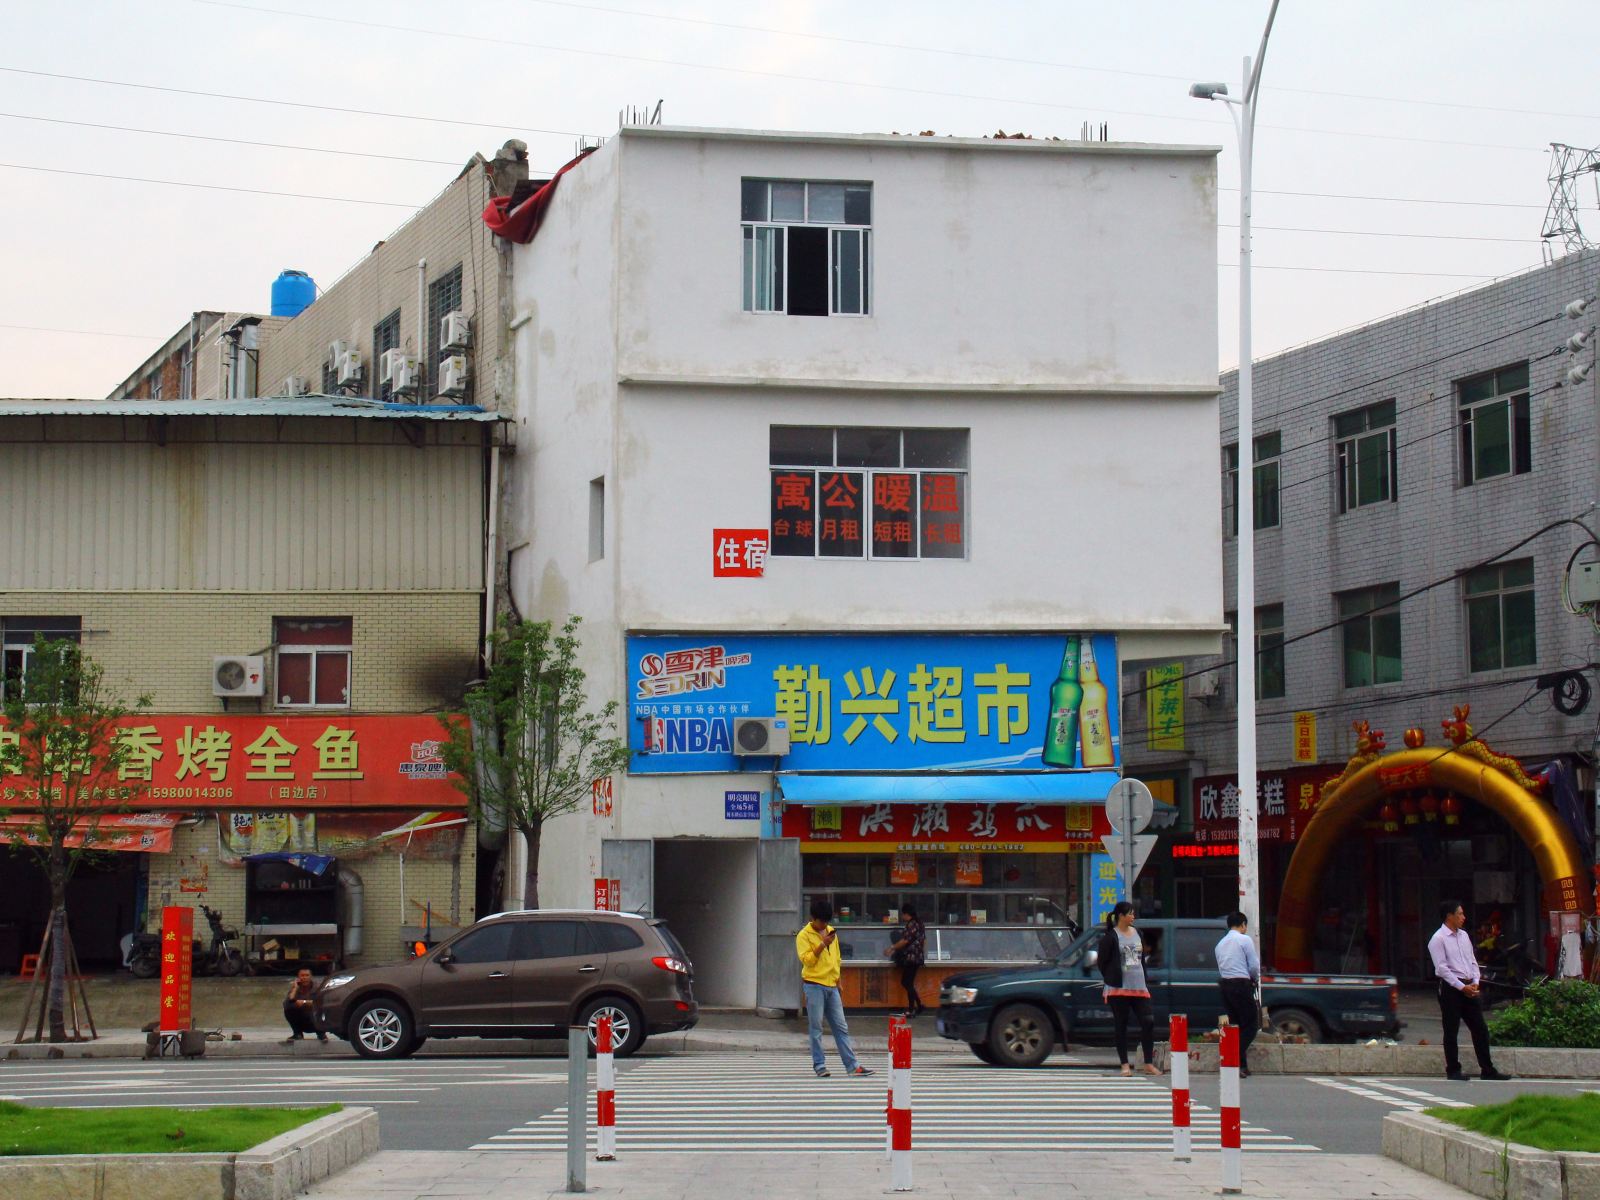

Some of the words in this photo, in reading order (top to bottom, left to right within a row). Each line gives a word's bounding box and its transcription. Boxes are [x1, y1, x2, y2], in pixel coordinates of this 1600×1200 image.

[774, 519, 813, 537] 台球
[822, 520, 859, 541] 月租
[874, 521, 912, 543] 短租
[924, 523, 961, 545] 长租
[716, 537, 767, 570] 住宿
[665, 647, 724, 675] 雪津
[725, 655, 750, 665] 啤酒
[636, 705, 658, 715] NBA
[661, 704, 750, 714] 中国市场合作伙伴
[773, 664, 1031, 746] 勤兴超市
[666, 717, 731, 752] NBA
[1297, 715, 1312, 760] 生日蛋糕
[1199, 778, 1286, 820] 欣鑫糕
